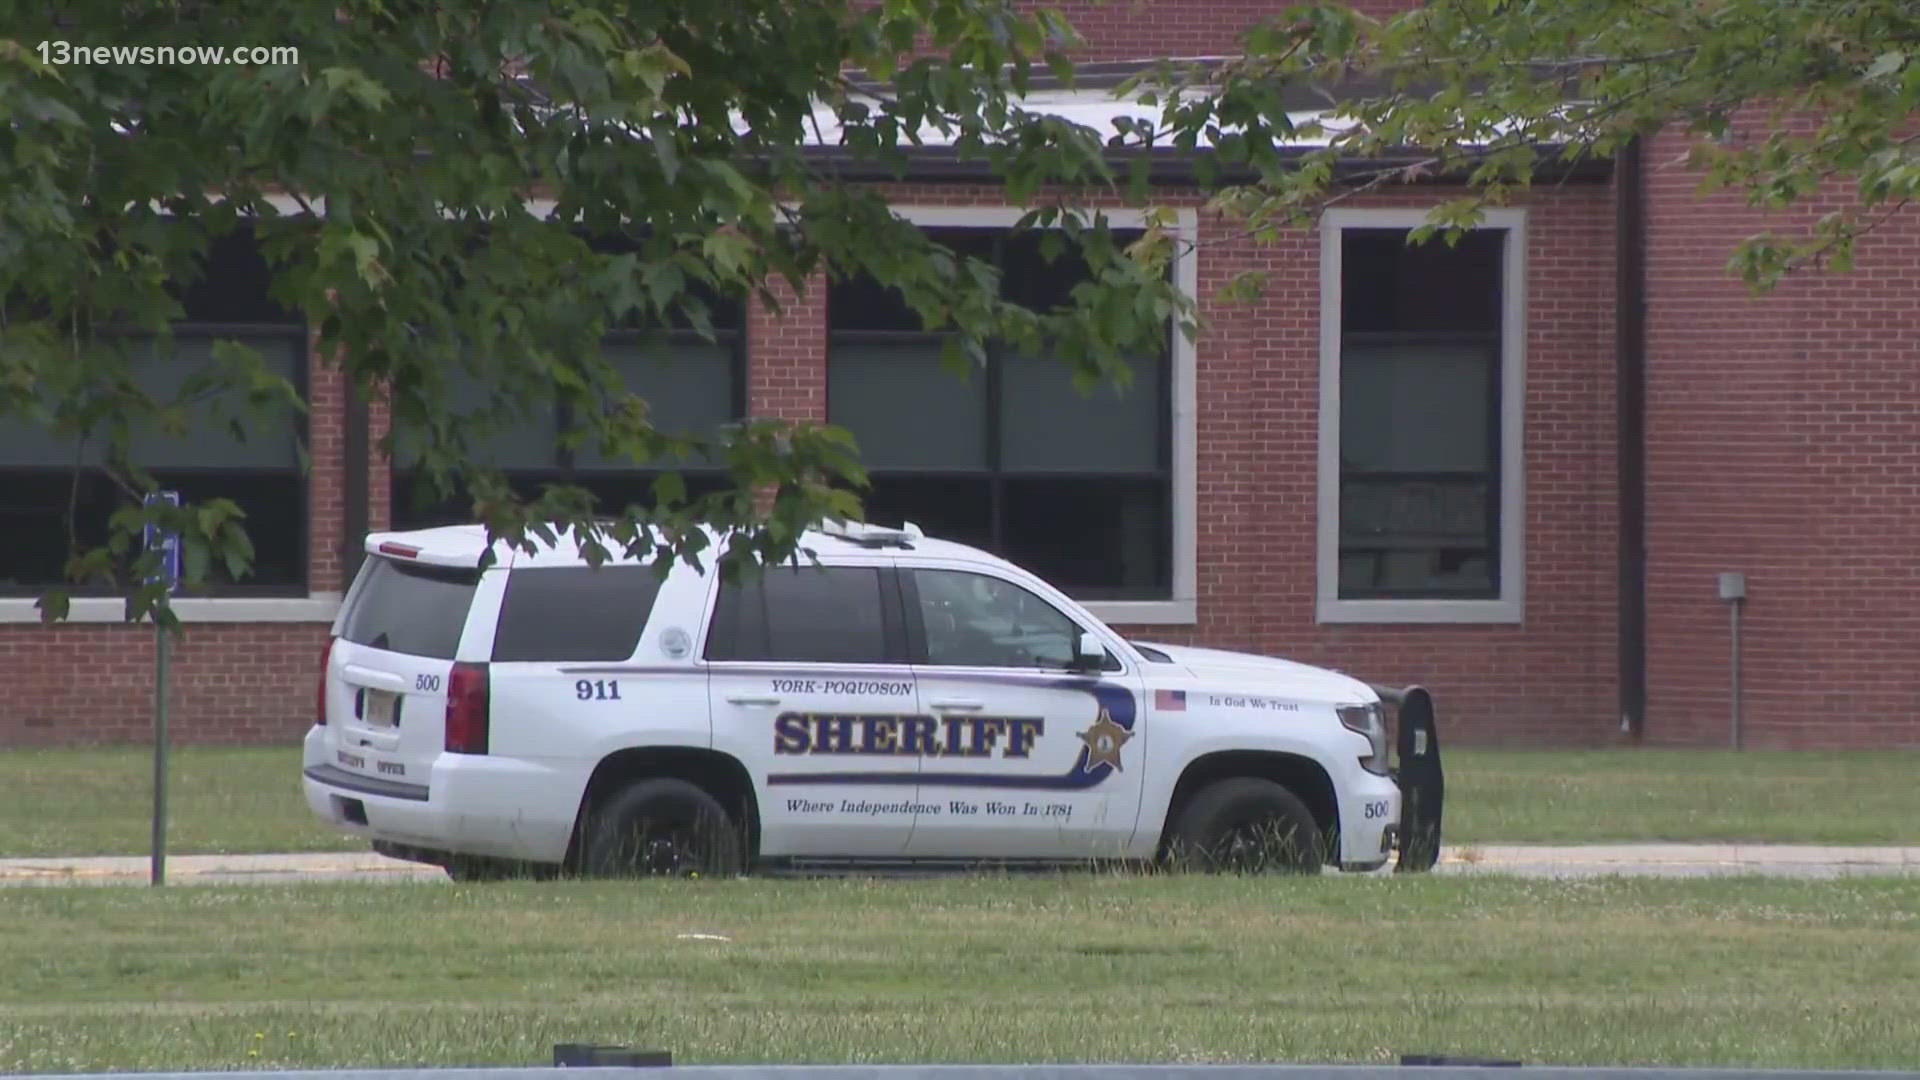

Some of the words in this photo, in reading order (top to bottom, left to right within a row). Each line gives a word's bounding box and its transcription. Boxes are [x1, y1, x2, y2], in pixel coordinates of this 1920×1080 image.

[416, 674, 440, 691] 500
[575, 679, 622, 700] 911
[771, 679, 913, 697] YORK-POQUOSON
[1209, 695, 1220, 706] In
[1224, 696, 1246, 708] God
[1250, 698, 1266, 709] We
[1269, 700, 1299, 712] Trust
[774, 711, 1045, 759] SHERIFF
[787, 799, 834, 813] Where
[840, 799, 941, 816] Independence
[949, 801, 978, 815] Was
[986, 801, 1016, 816] Won
[1023, 802, 1038, 816] In
[1045, 803, 1072, 816] 1781
[1364, 799, 1389, 819] 500
